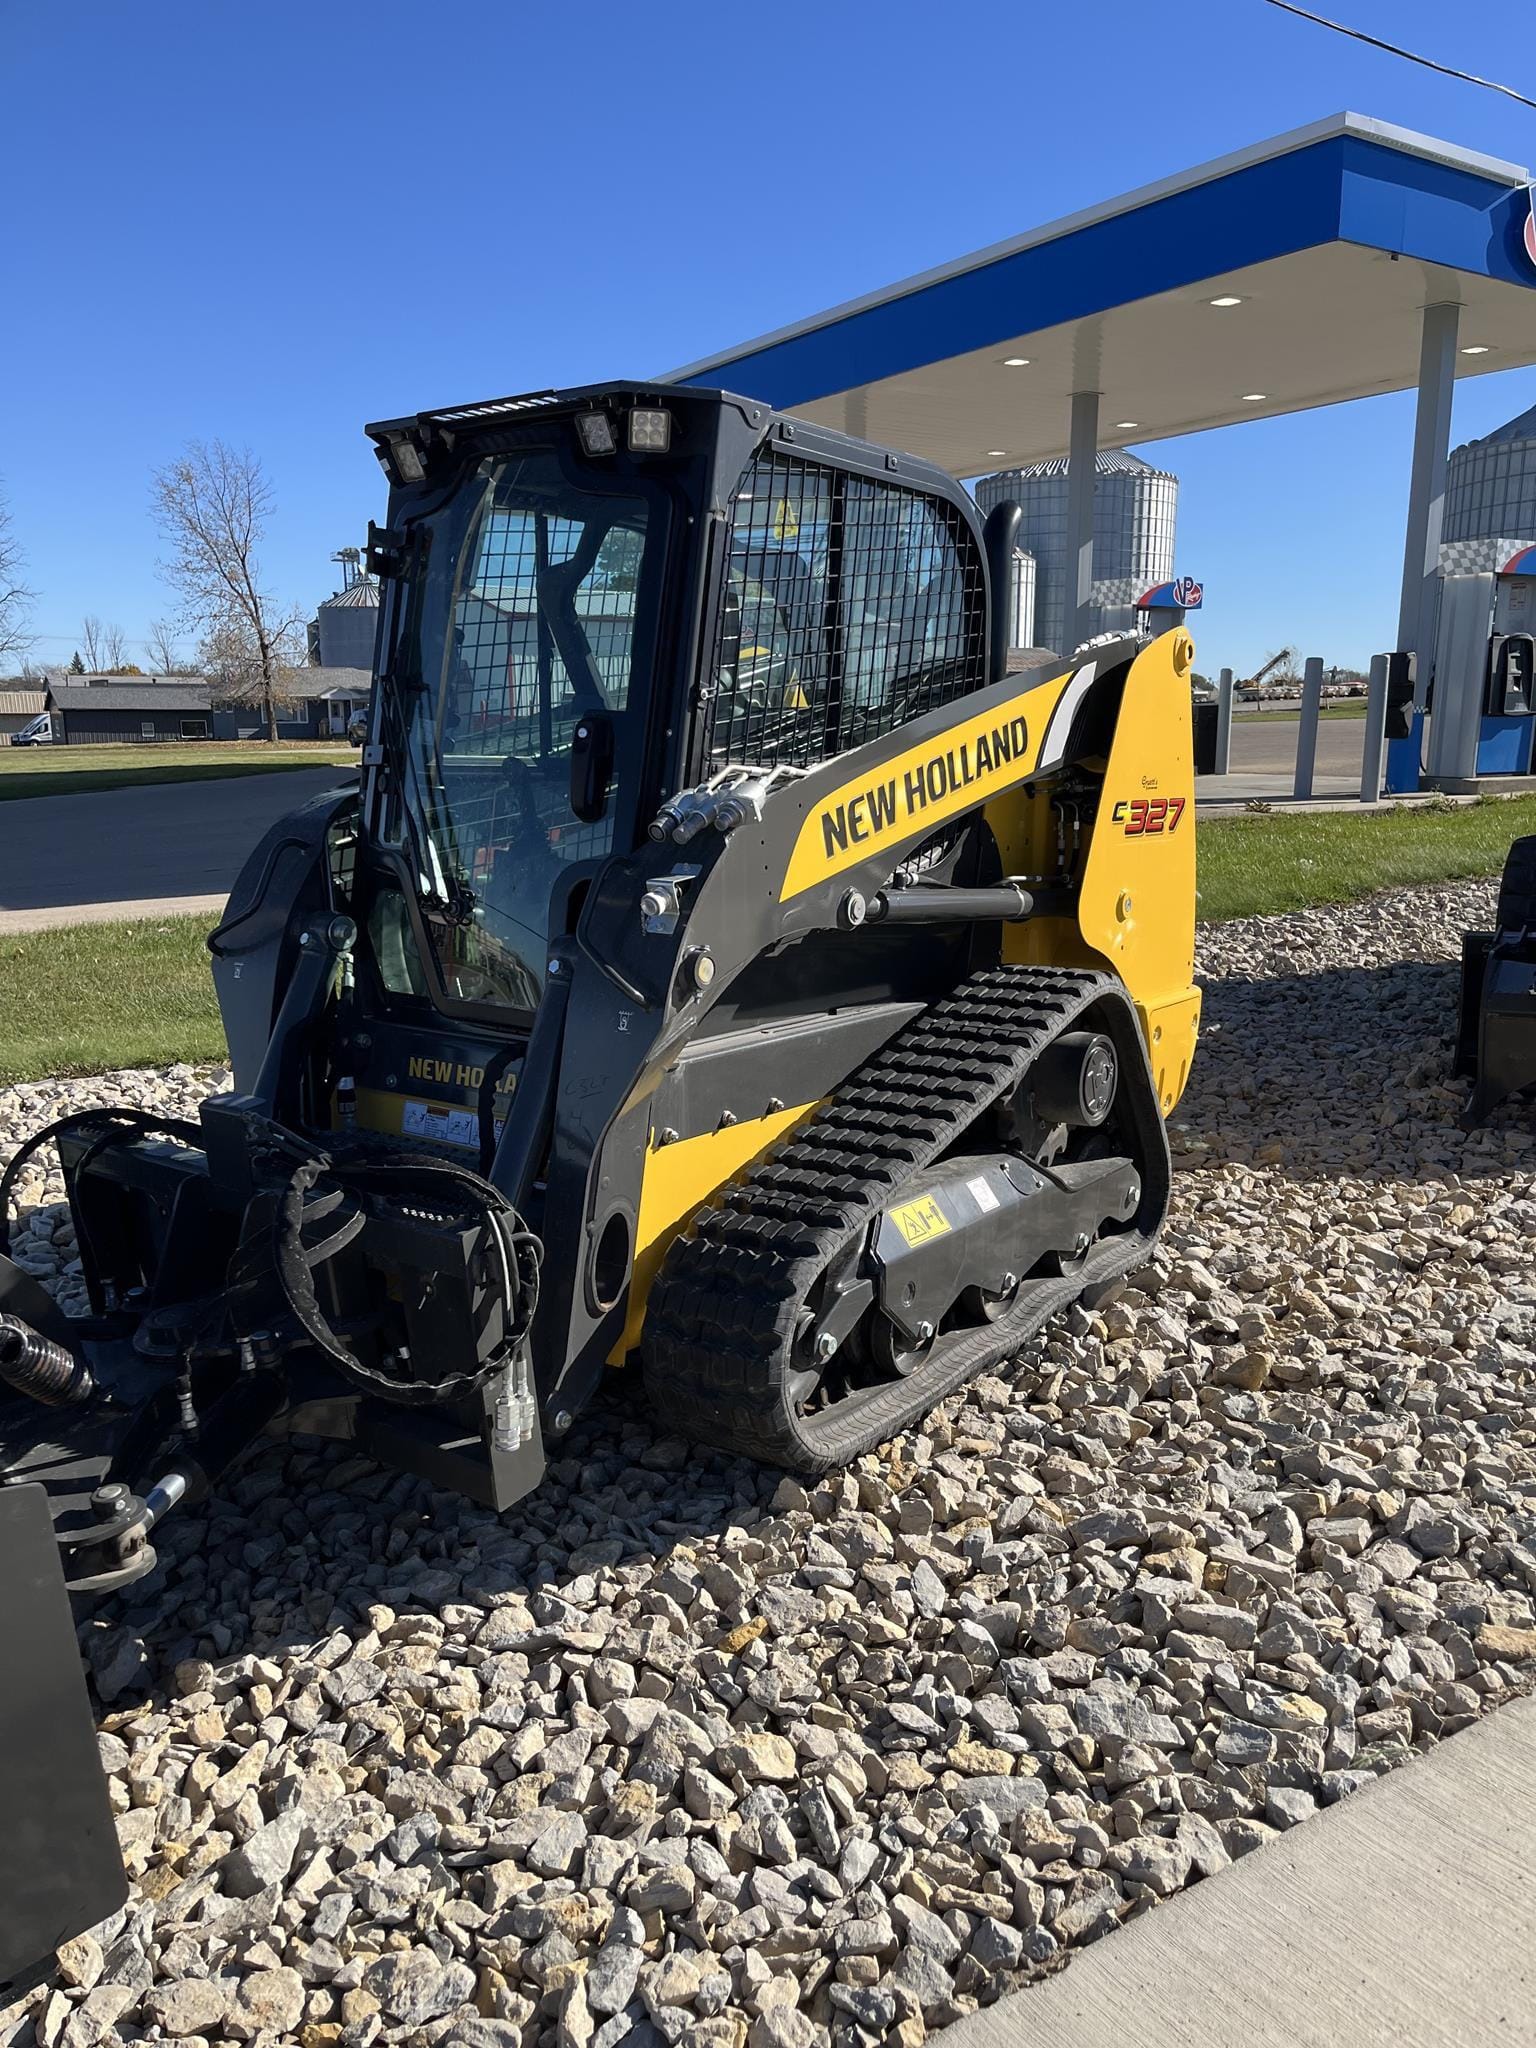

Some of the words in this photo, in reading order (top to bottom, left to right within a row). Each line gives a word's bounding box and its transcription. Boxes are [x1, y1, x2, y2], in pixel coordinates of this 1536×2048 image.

[821, 778, 896, 859] NEW
[904, 716, 1028, 816] HOLLAND
[1111, 797, 1186, 836] C327
[408, 1056, 453, 1084] NEW
[455, 1064, 517, 1094] HOLA
